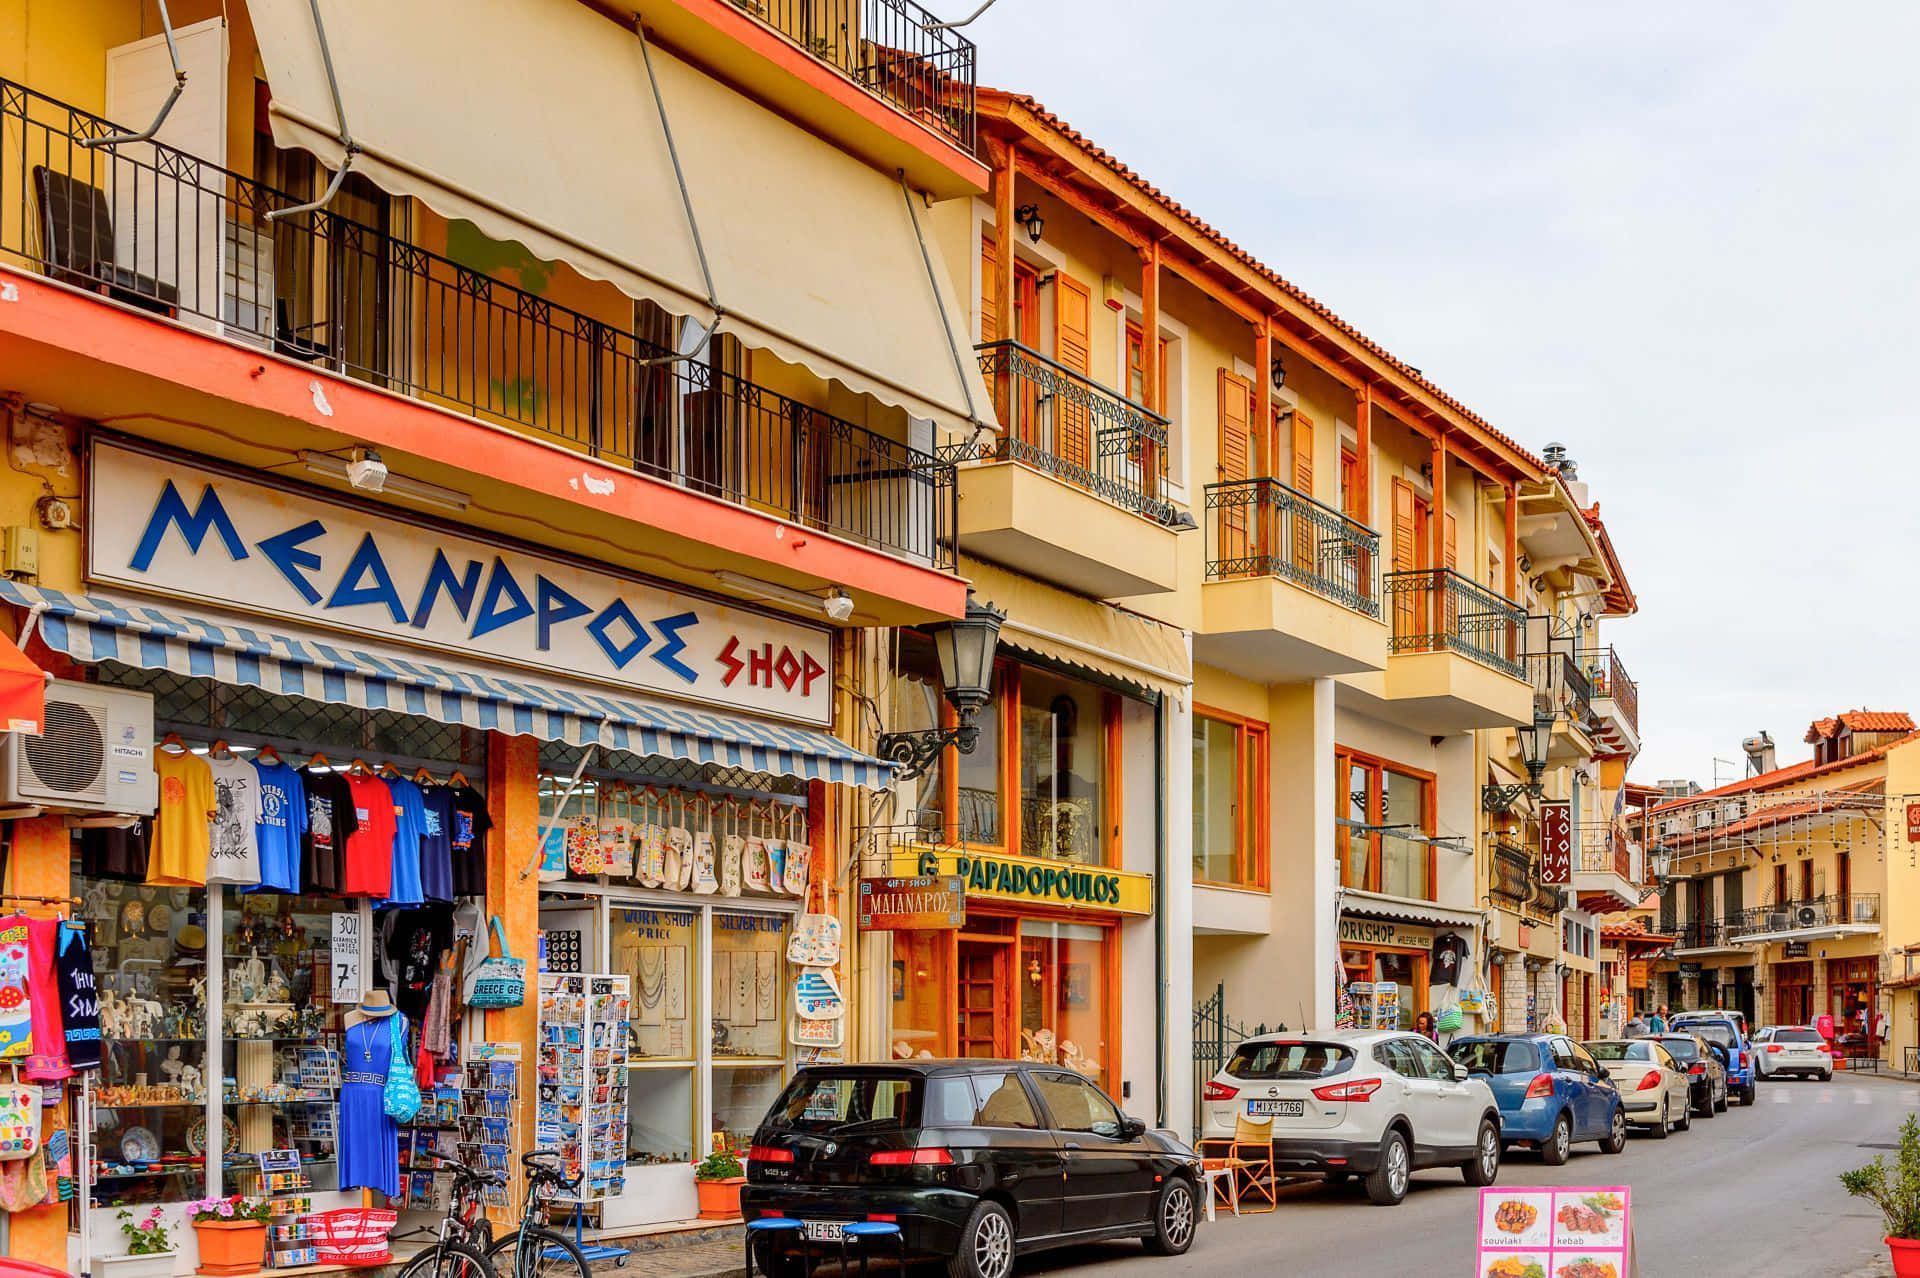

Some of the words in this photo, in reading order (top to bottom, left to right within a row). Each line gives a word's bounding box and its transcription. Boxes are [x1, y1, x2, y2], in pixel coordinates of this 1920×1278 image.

[716, 635, 826, 697] SHOP
[114, 747, 143, 757] HITACHI
[213, 777, 247, 790] EUS
[1542, 807, 1555, 882] PITHO
[1557, 807, 1570, 882] ROOMS
[887, 879, 906, 888] GIFT
[909, 879, 932, 888] SHOP
[956, 857, 1120, 904] PAPADOPOULOS
[623, 909, 660, 925] WORK
[664, 911, 693, 928] SHOP
[719, 914, 756, 932] SILVER
[1339, 920, 1395, 944] ORKSHOP
[473, 984, 505, 995] GREECE
[1484, 1237, 1522, 1246] souvlaki
[1557, 1236, 1585, 1246] kebab
